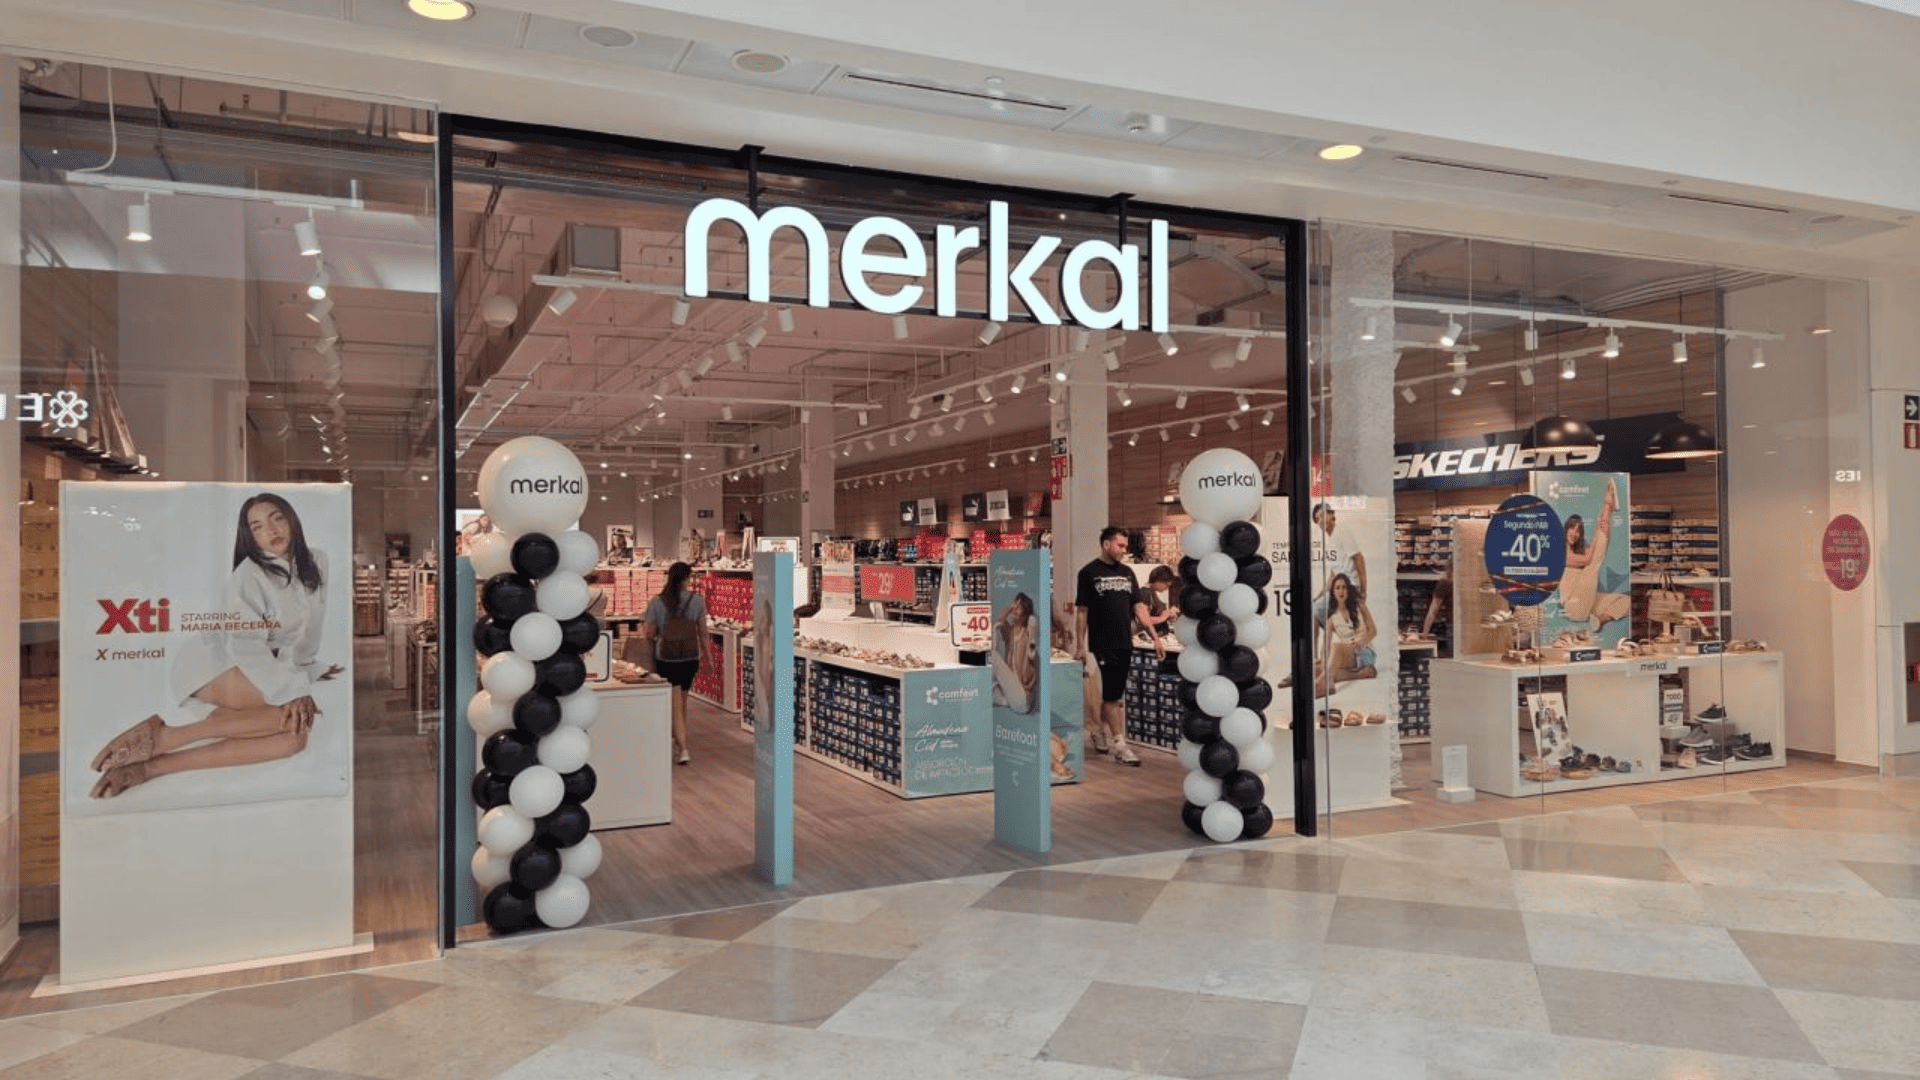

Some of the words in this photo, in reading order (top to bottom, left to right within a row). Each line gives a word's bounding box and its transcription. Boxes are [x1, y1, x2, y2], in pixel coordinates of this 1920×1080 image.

[685, 198, 1169, 333] merkal
[510, 475, 583, 495] merkal
[1198, 471, 1257, 489] merkal
[96, 598, 170, 635] Xti
[181, 612, 241, 622] STARRING
[225, 621, 282, 631] BECERRA
[96, 648, 108, 661] X
[112, 647, 165, 660] merkal
[1640, 660, 1667, 672] merkal
